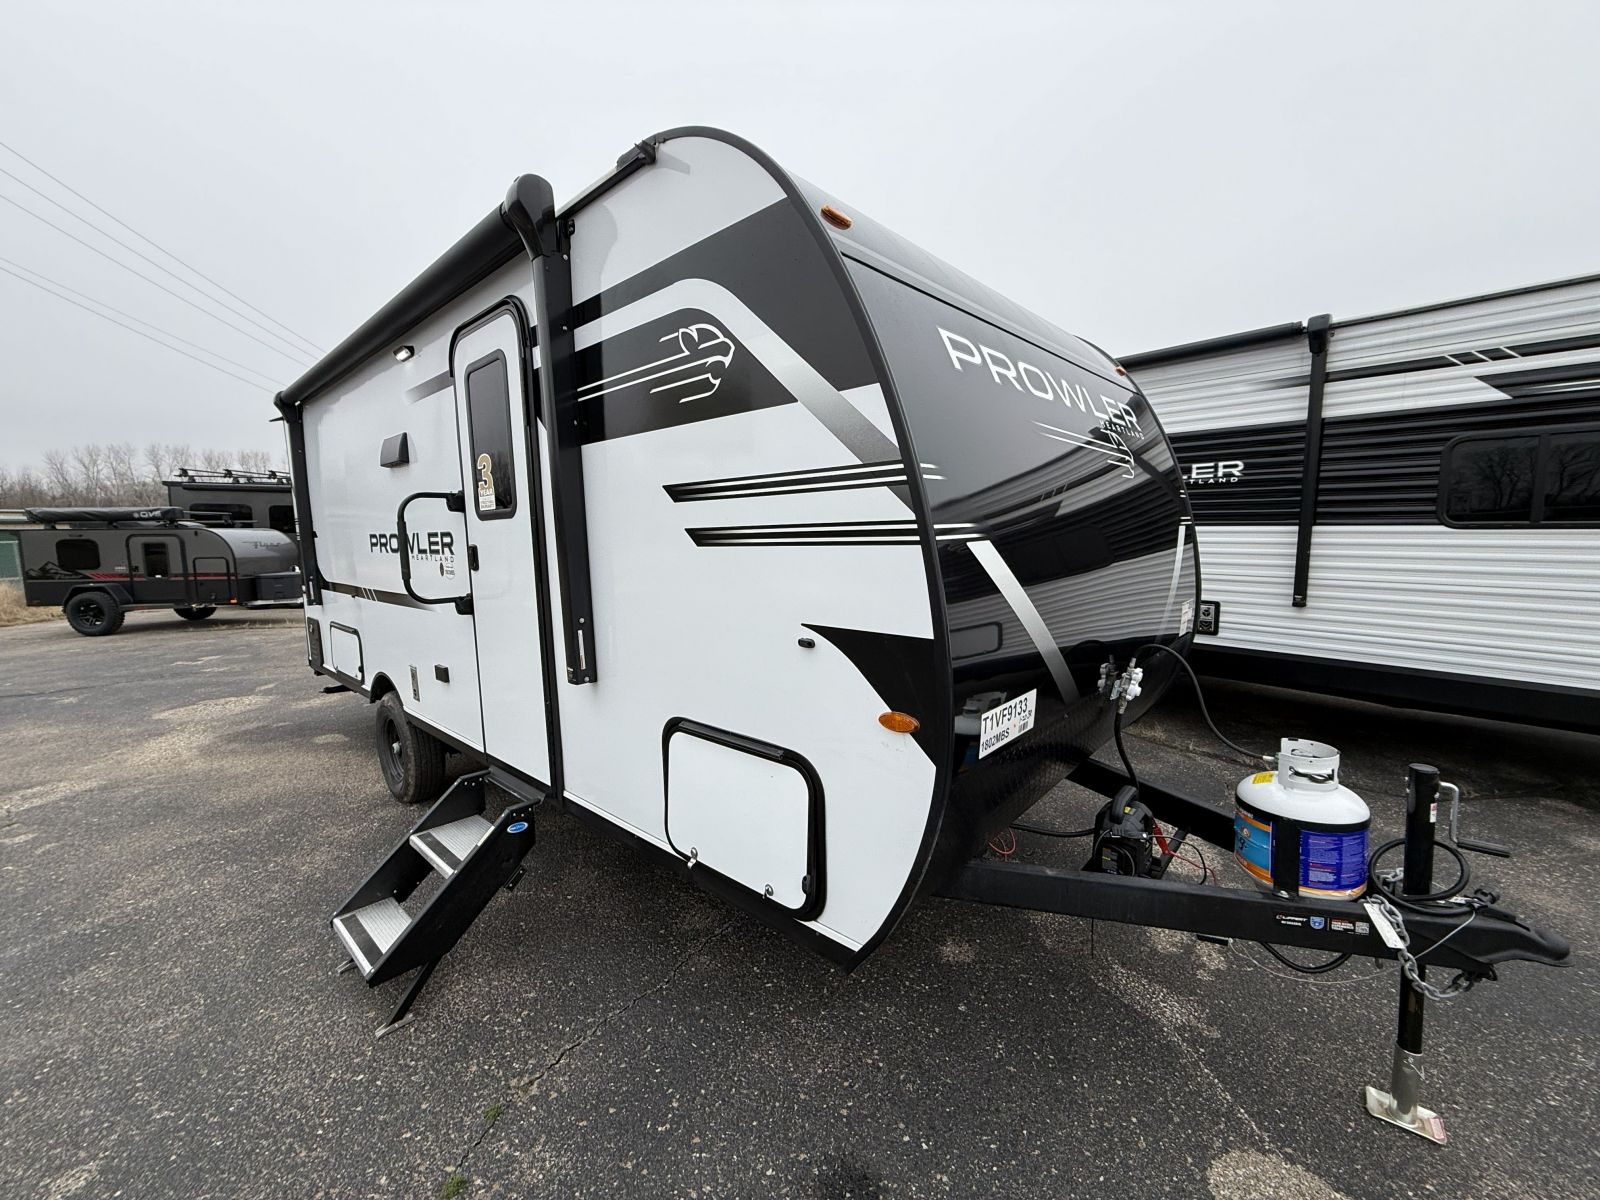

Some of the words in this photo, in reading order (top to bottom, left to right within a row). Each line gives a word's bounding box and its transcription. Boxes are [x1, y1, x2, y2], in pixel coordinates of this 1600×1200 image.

[936, 326, 1142, 432] PROWLER
[1100, 419, 1145, 440] HEARTLAND
[477, 453, 494, 490] 3
[411, 555, 455, 563] HEARTLAND
[983, 697, 1028, 735] T1VF9133
[981, 727, 1010, 753] 1802MBS
